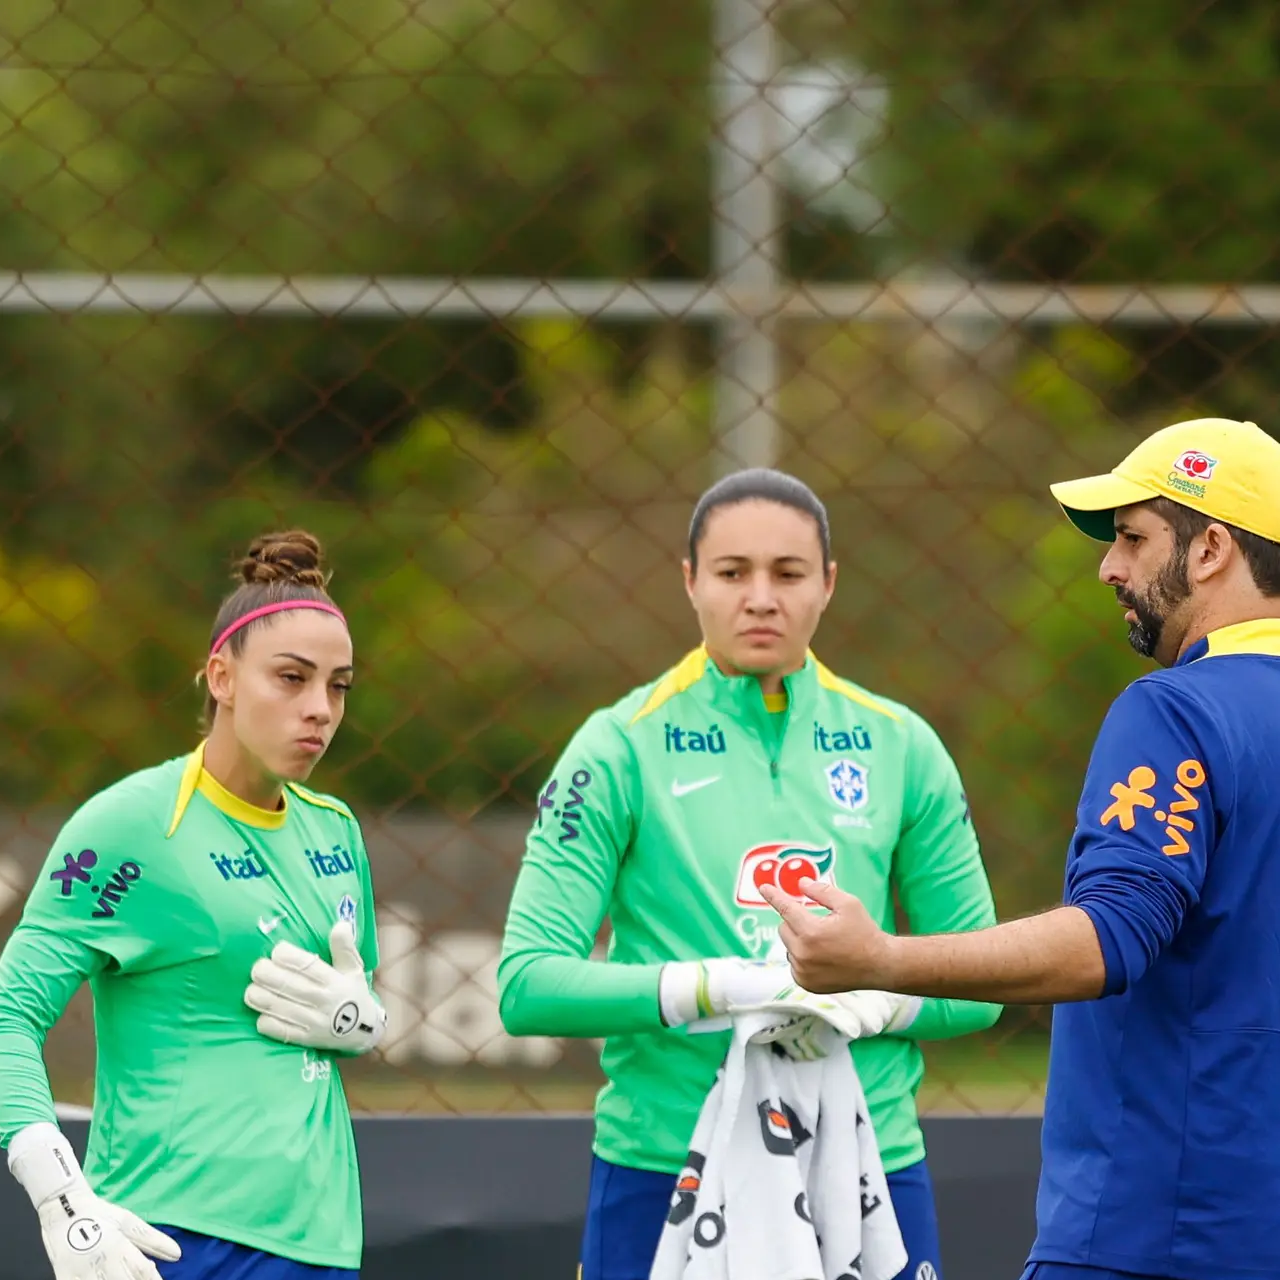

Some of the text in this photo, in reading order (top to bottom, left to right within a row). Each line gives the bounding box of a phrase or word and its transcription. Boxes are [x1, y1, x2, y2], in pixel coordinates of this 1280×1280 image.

[664, 723, 727, 754] itaú
[813, 721, 873, 753] itaú
[558, 769, 592, 844] vivo
[1154, 758, 1207, 857] vivo
[209, 846, 270, 881] itaú
[304, 845, 356, 879] itaú
[91, 860, 141, 918] vivo
